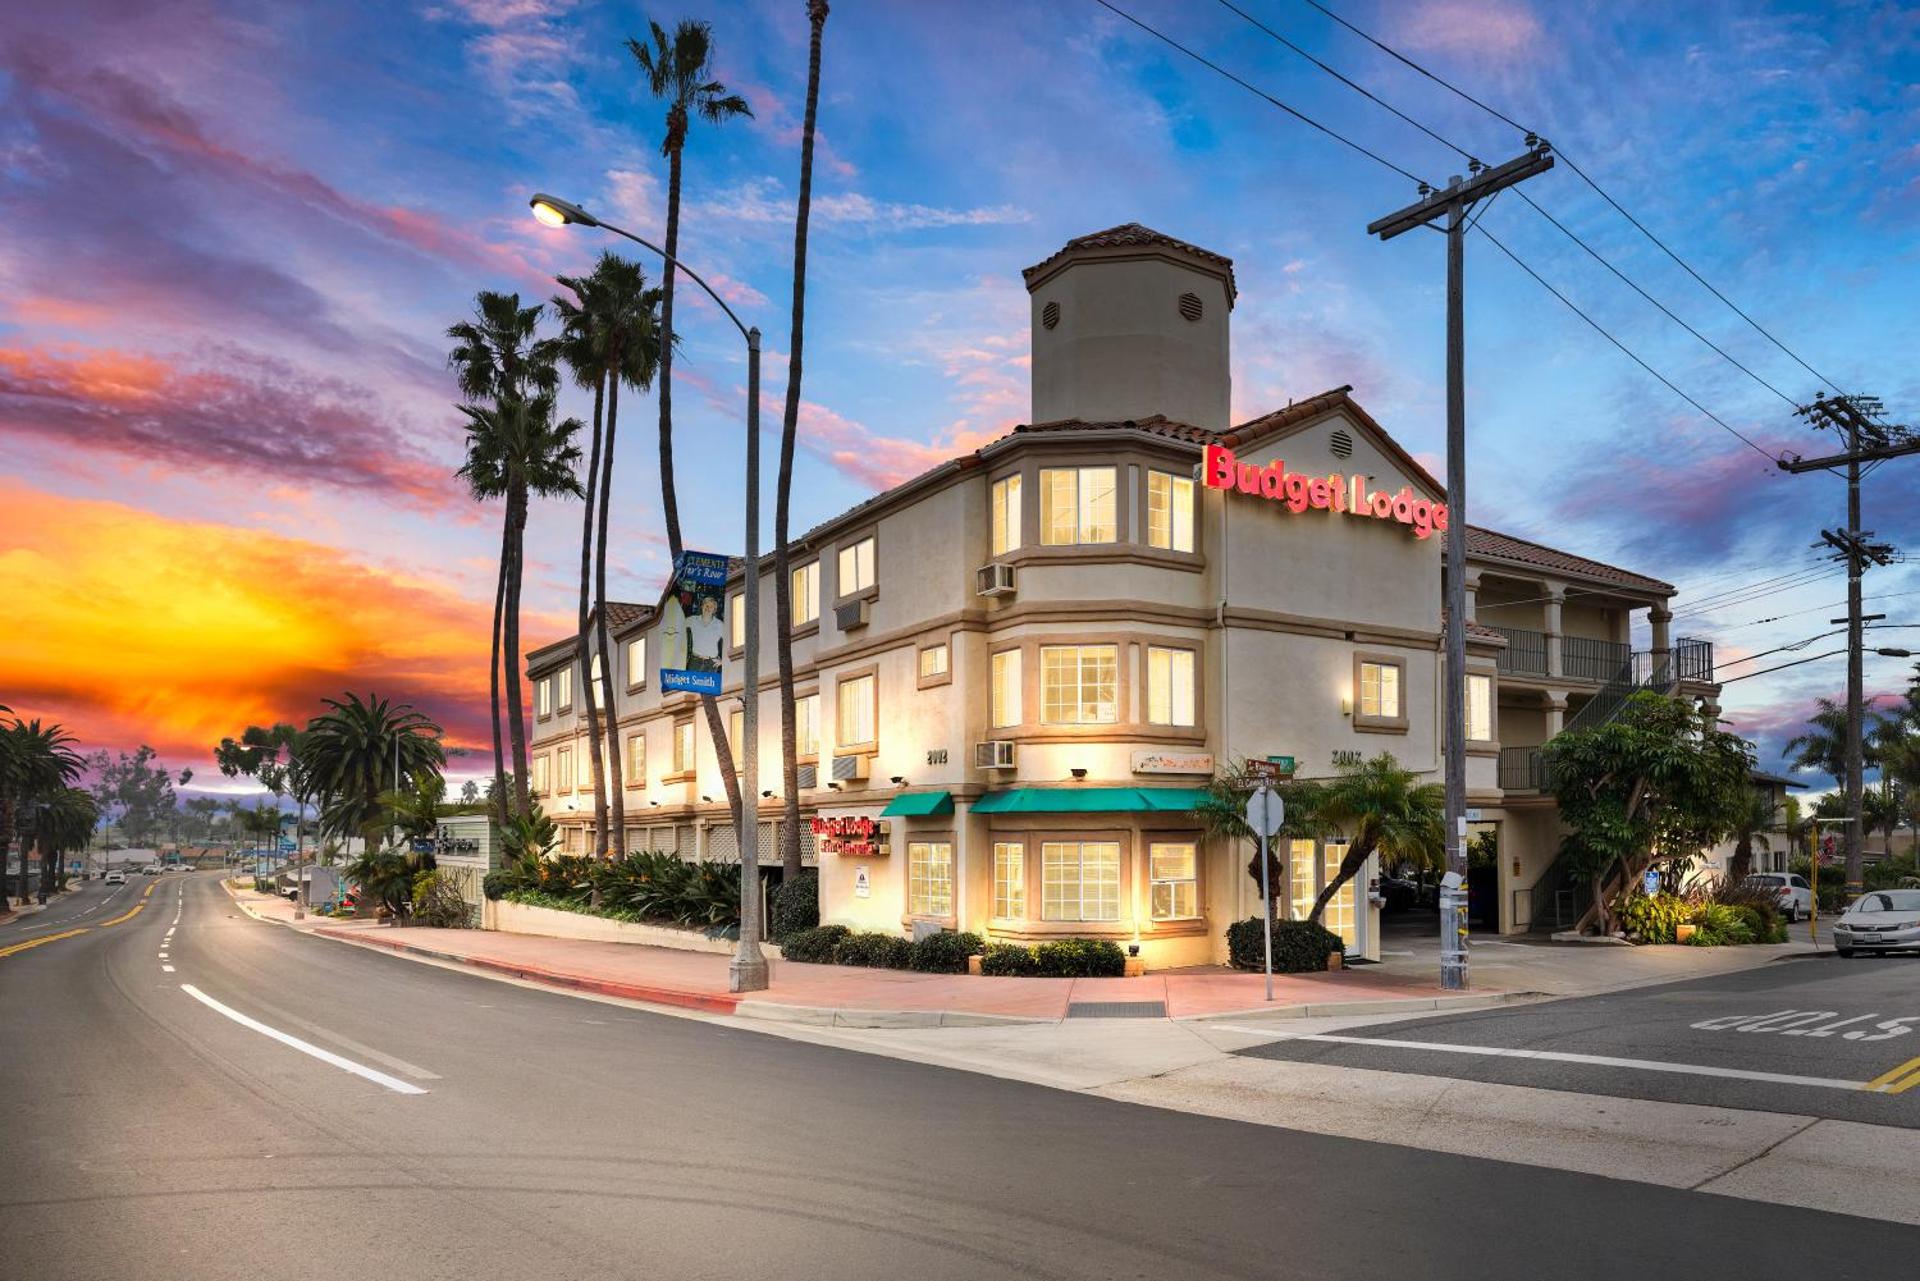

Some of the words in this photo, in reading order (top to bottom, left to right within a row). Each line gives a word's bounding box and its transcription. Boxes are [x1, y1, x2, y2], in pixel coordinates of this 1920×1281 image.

[1202, 444, 1346, 513] Budget
[1351, 474, 1449, 540] Lodge
[691, 675, 715, 687] Smith
[811, 816, 846, 838] Budget
[846, 816, 874, 842] Lodge
